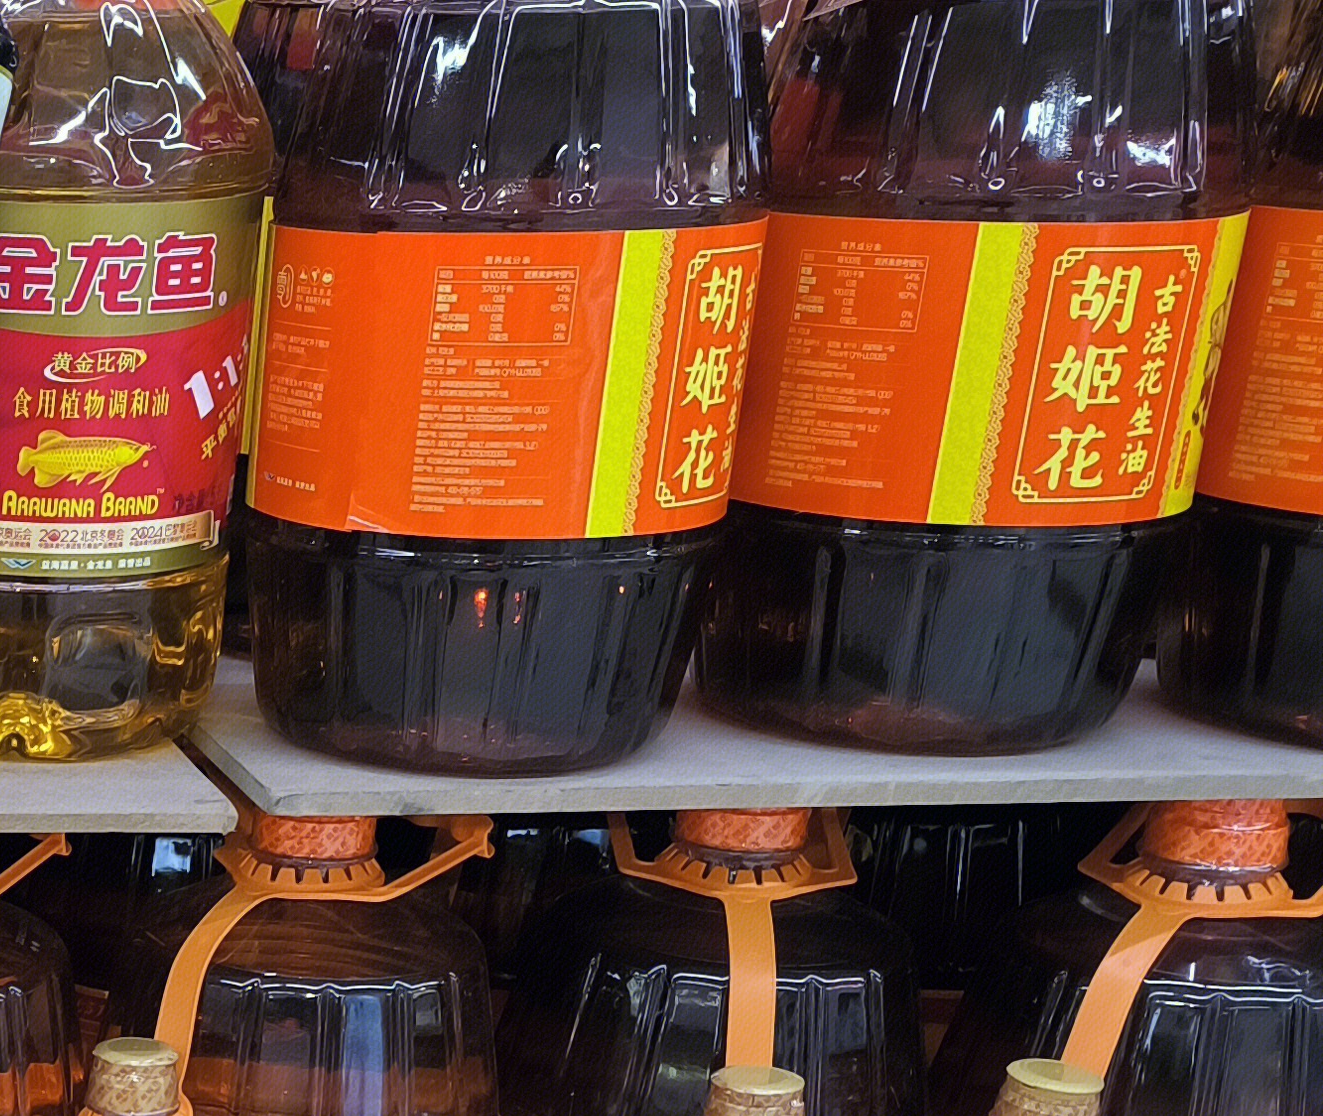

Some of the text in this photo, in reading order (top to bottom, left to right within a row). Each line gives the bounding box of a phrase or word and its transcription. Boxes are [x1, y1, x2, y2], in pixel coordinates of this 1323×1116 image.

[12, 386, 170, 420] 食用植物调和油
[52, 350, 137, 375] 黄金比例
[672, 262, 745, 494] 胡姬花
[1034, 263, 1143, 492] 胡姬花
[1118, 274, 1183, 477] 古法花生油
[1, 489, 159, 518] ARAWANA BRAND
